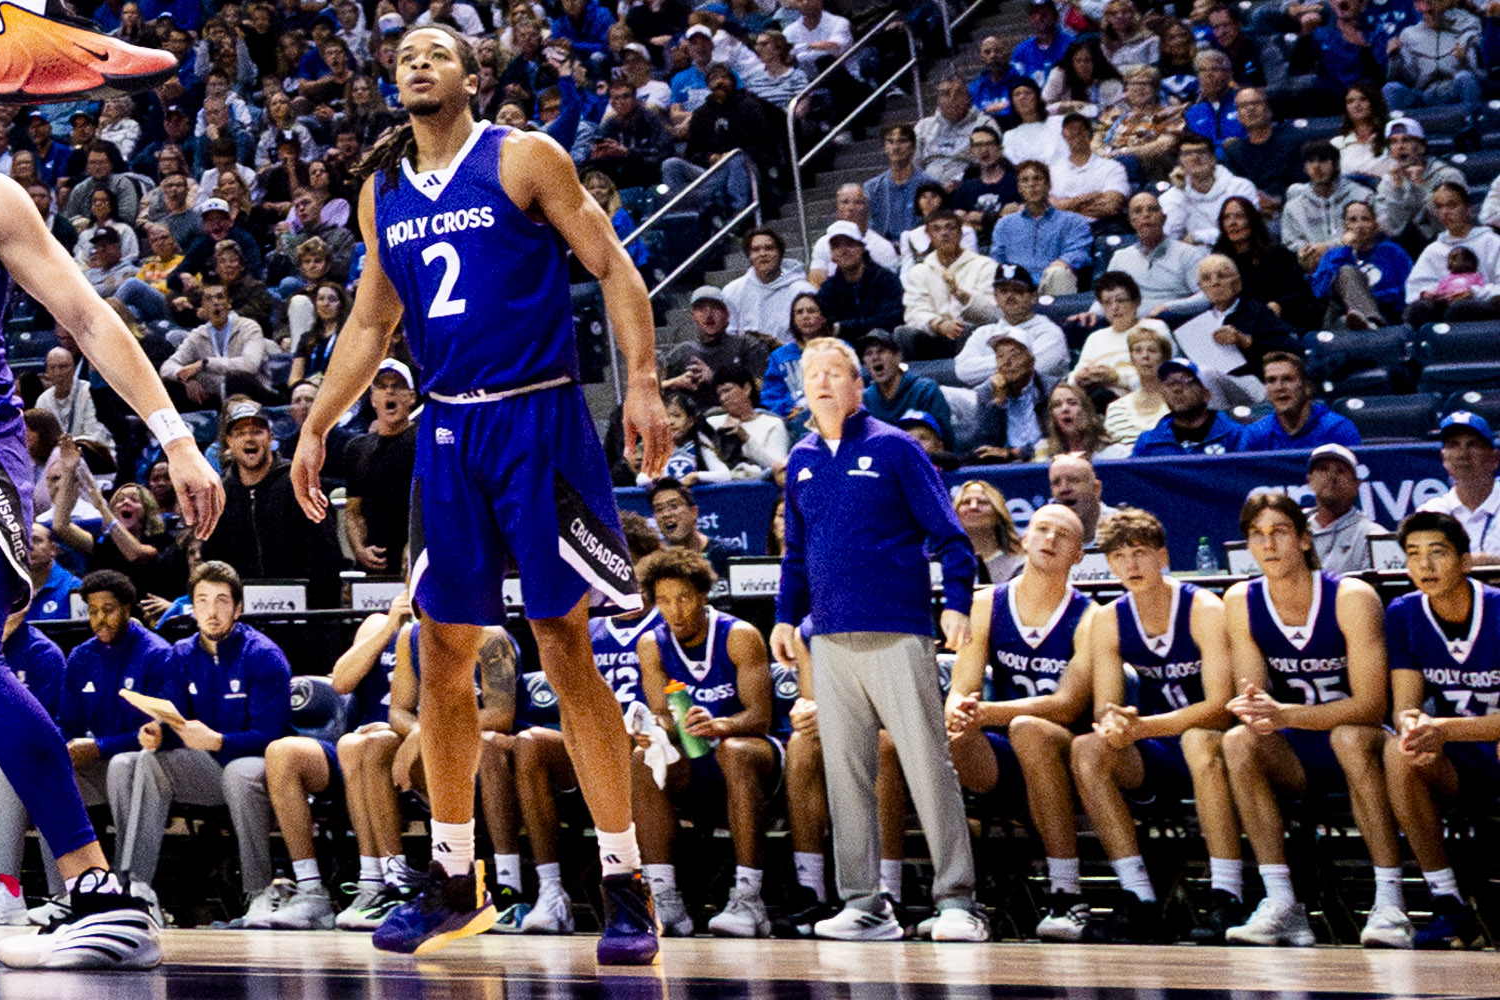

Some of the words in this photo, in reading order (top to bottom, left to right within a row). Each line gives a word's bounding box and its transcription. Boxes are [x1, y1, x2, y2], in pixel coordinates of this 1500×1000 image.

[386, 216, 429, 248] HOLY
[431, 206, 495, 235] CROSS
[421, 241, 467, 319] 2
[570, 517, 632, 582] CRUSADERS
[594, 652, 618, 666] OLY
[997, 650, 1029, 671] HOLY
[1030, 656, 1069, 674] CROS
[1423, 668, 1460, 685] HOLY
